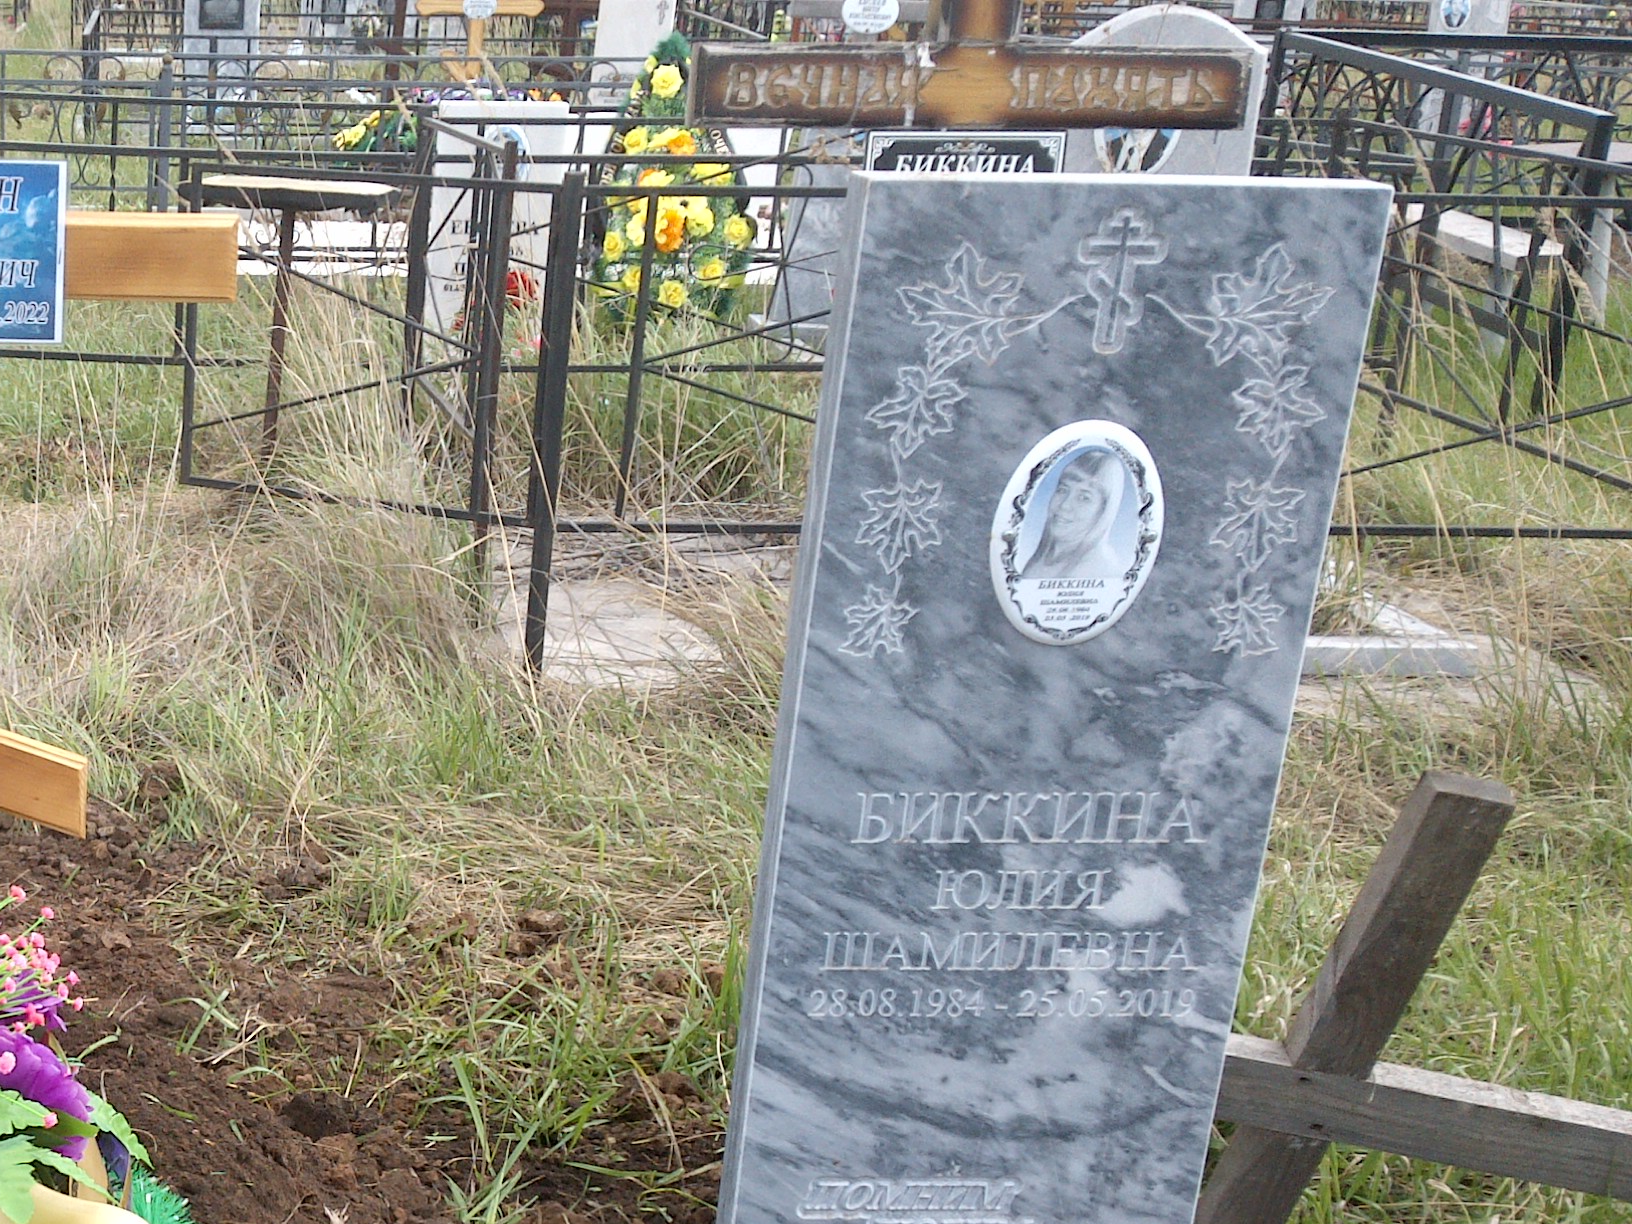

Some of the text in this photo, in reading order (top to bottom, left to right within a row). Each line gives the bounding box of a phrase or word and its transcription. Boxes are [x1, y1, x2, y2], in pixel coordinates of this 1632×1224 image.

[895, 154, 1035, 173] БИККИНА
[1037, 579, 1105, 590] БИККИНА
[850, 790, 1209, 845] БИККИНА
[930, 868, 1112, 911] ЮЛИЯ
[818, 931, 1200, 972] ШАМИЛЕВНА
[807, 989, 985, 1018] 28.08.1984
[1016, 988, 1197, 1019] 25.05.2019
[801, 1178, 1022, 1217] ПОМНИМ
